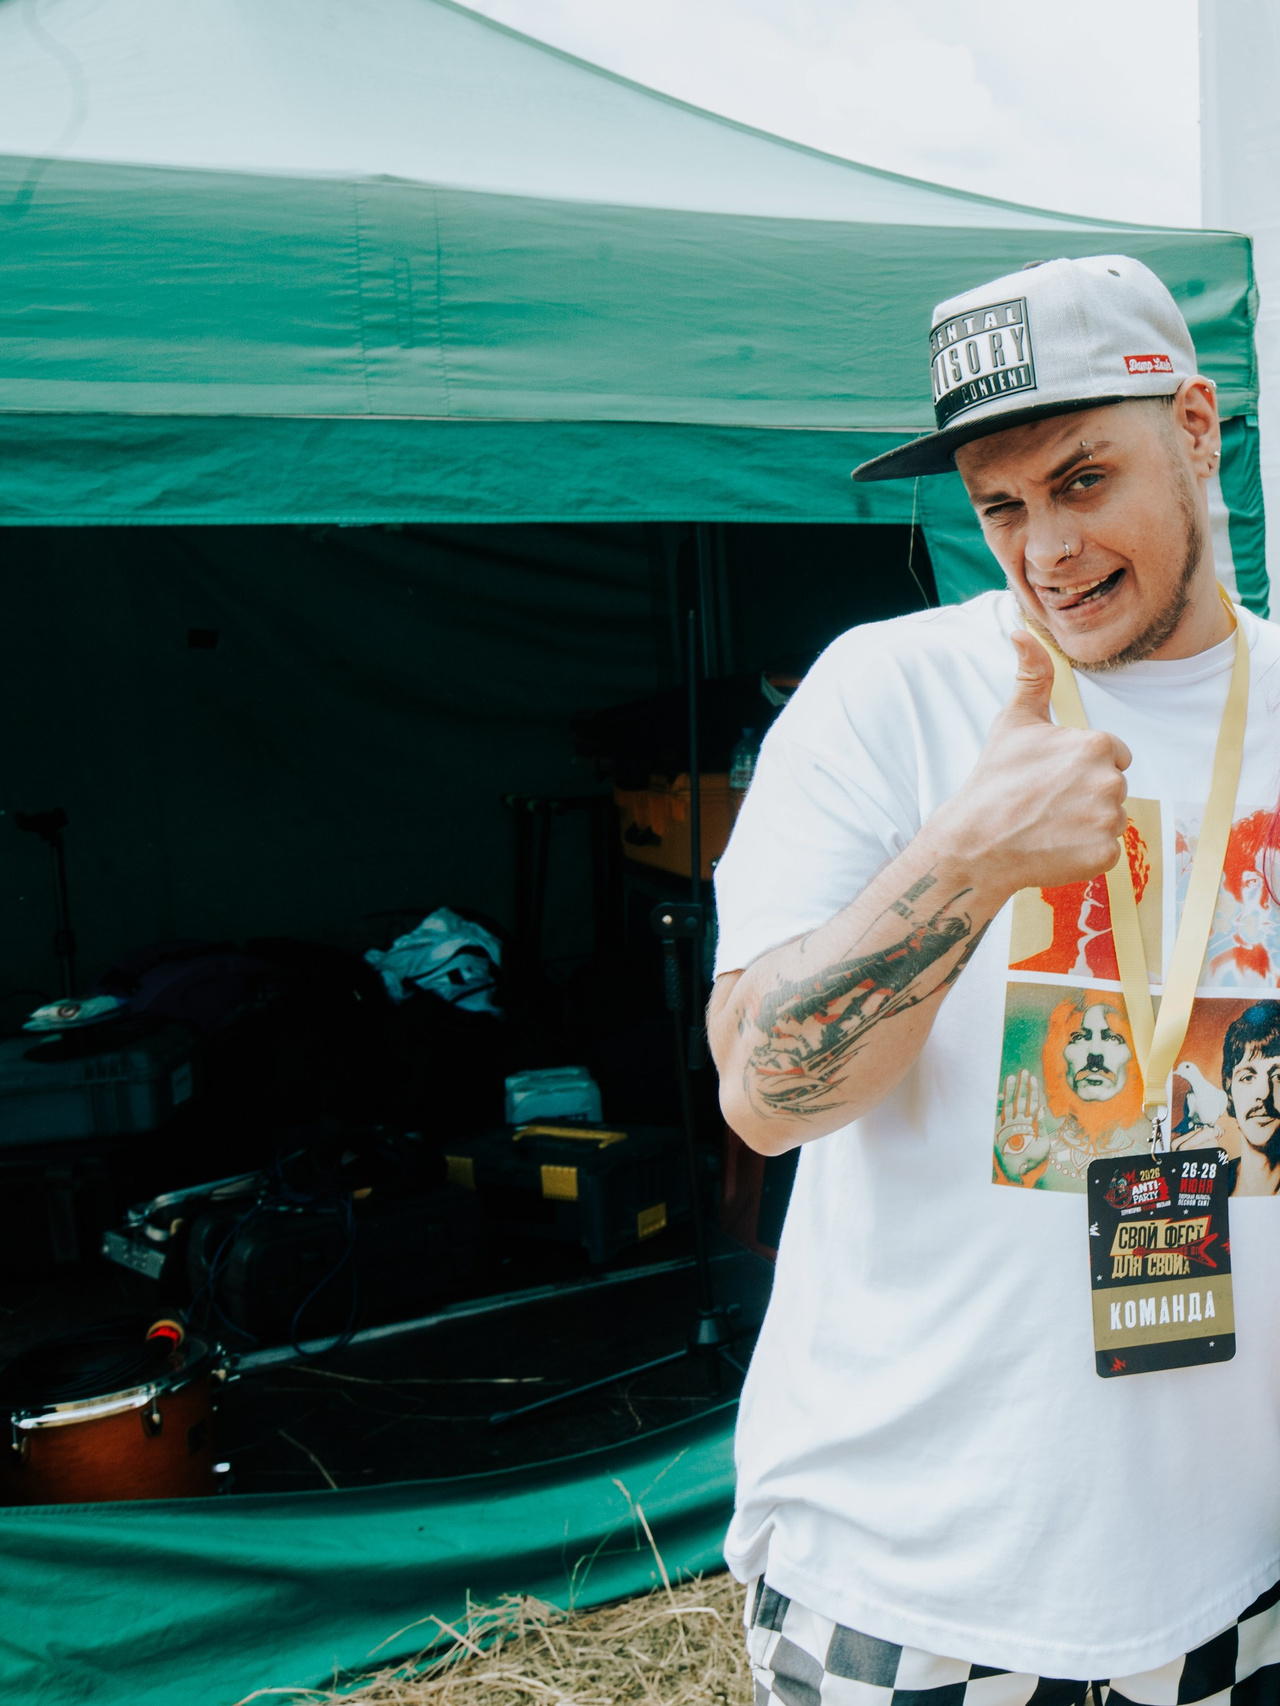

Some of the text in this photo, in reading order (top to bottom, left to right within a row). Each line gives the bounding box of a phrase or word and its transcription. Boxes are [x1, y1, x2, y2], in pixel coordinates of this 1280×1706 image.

[931, 307, 1017, 350] ENTAL
[961, 368, 1027, 403] CONTENT
[1139, 1167, 1160, 1182] 2026
[1180, 1177, 1214, 1194] ИЮНЯ
[1132, 1179, 1162, 1196] ANTI-
[1133, 1190, 1159, 1205] PARTY
[1118, 1222, 1158, 1249] СВОЙ
[1111, 1254, 1142, 1279] ДЛЯ
[1110, 1290, 1216, 1330] КОМАНДА
